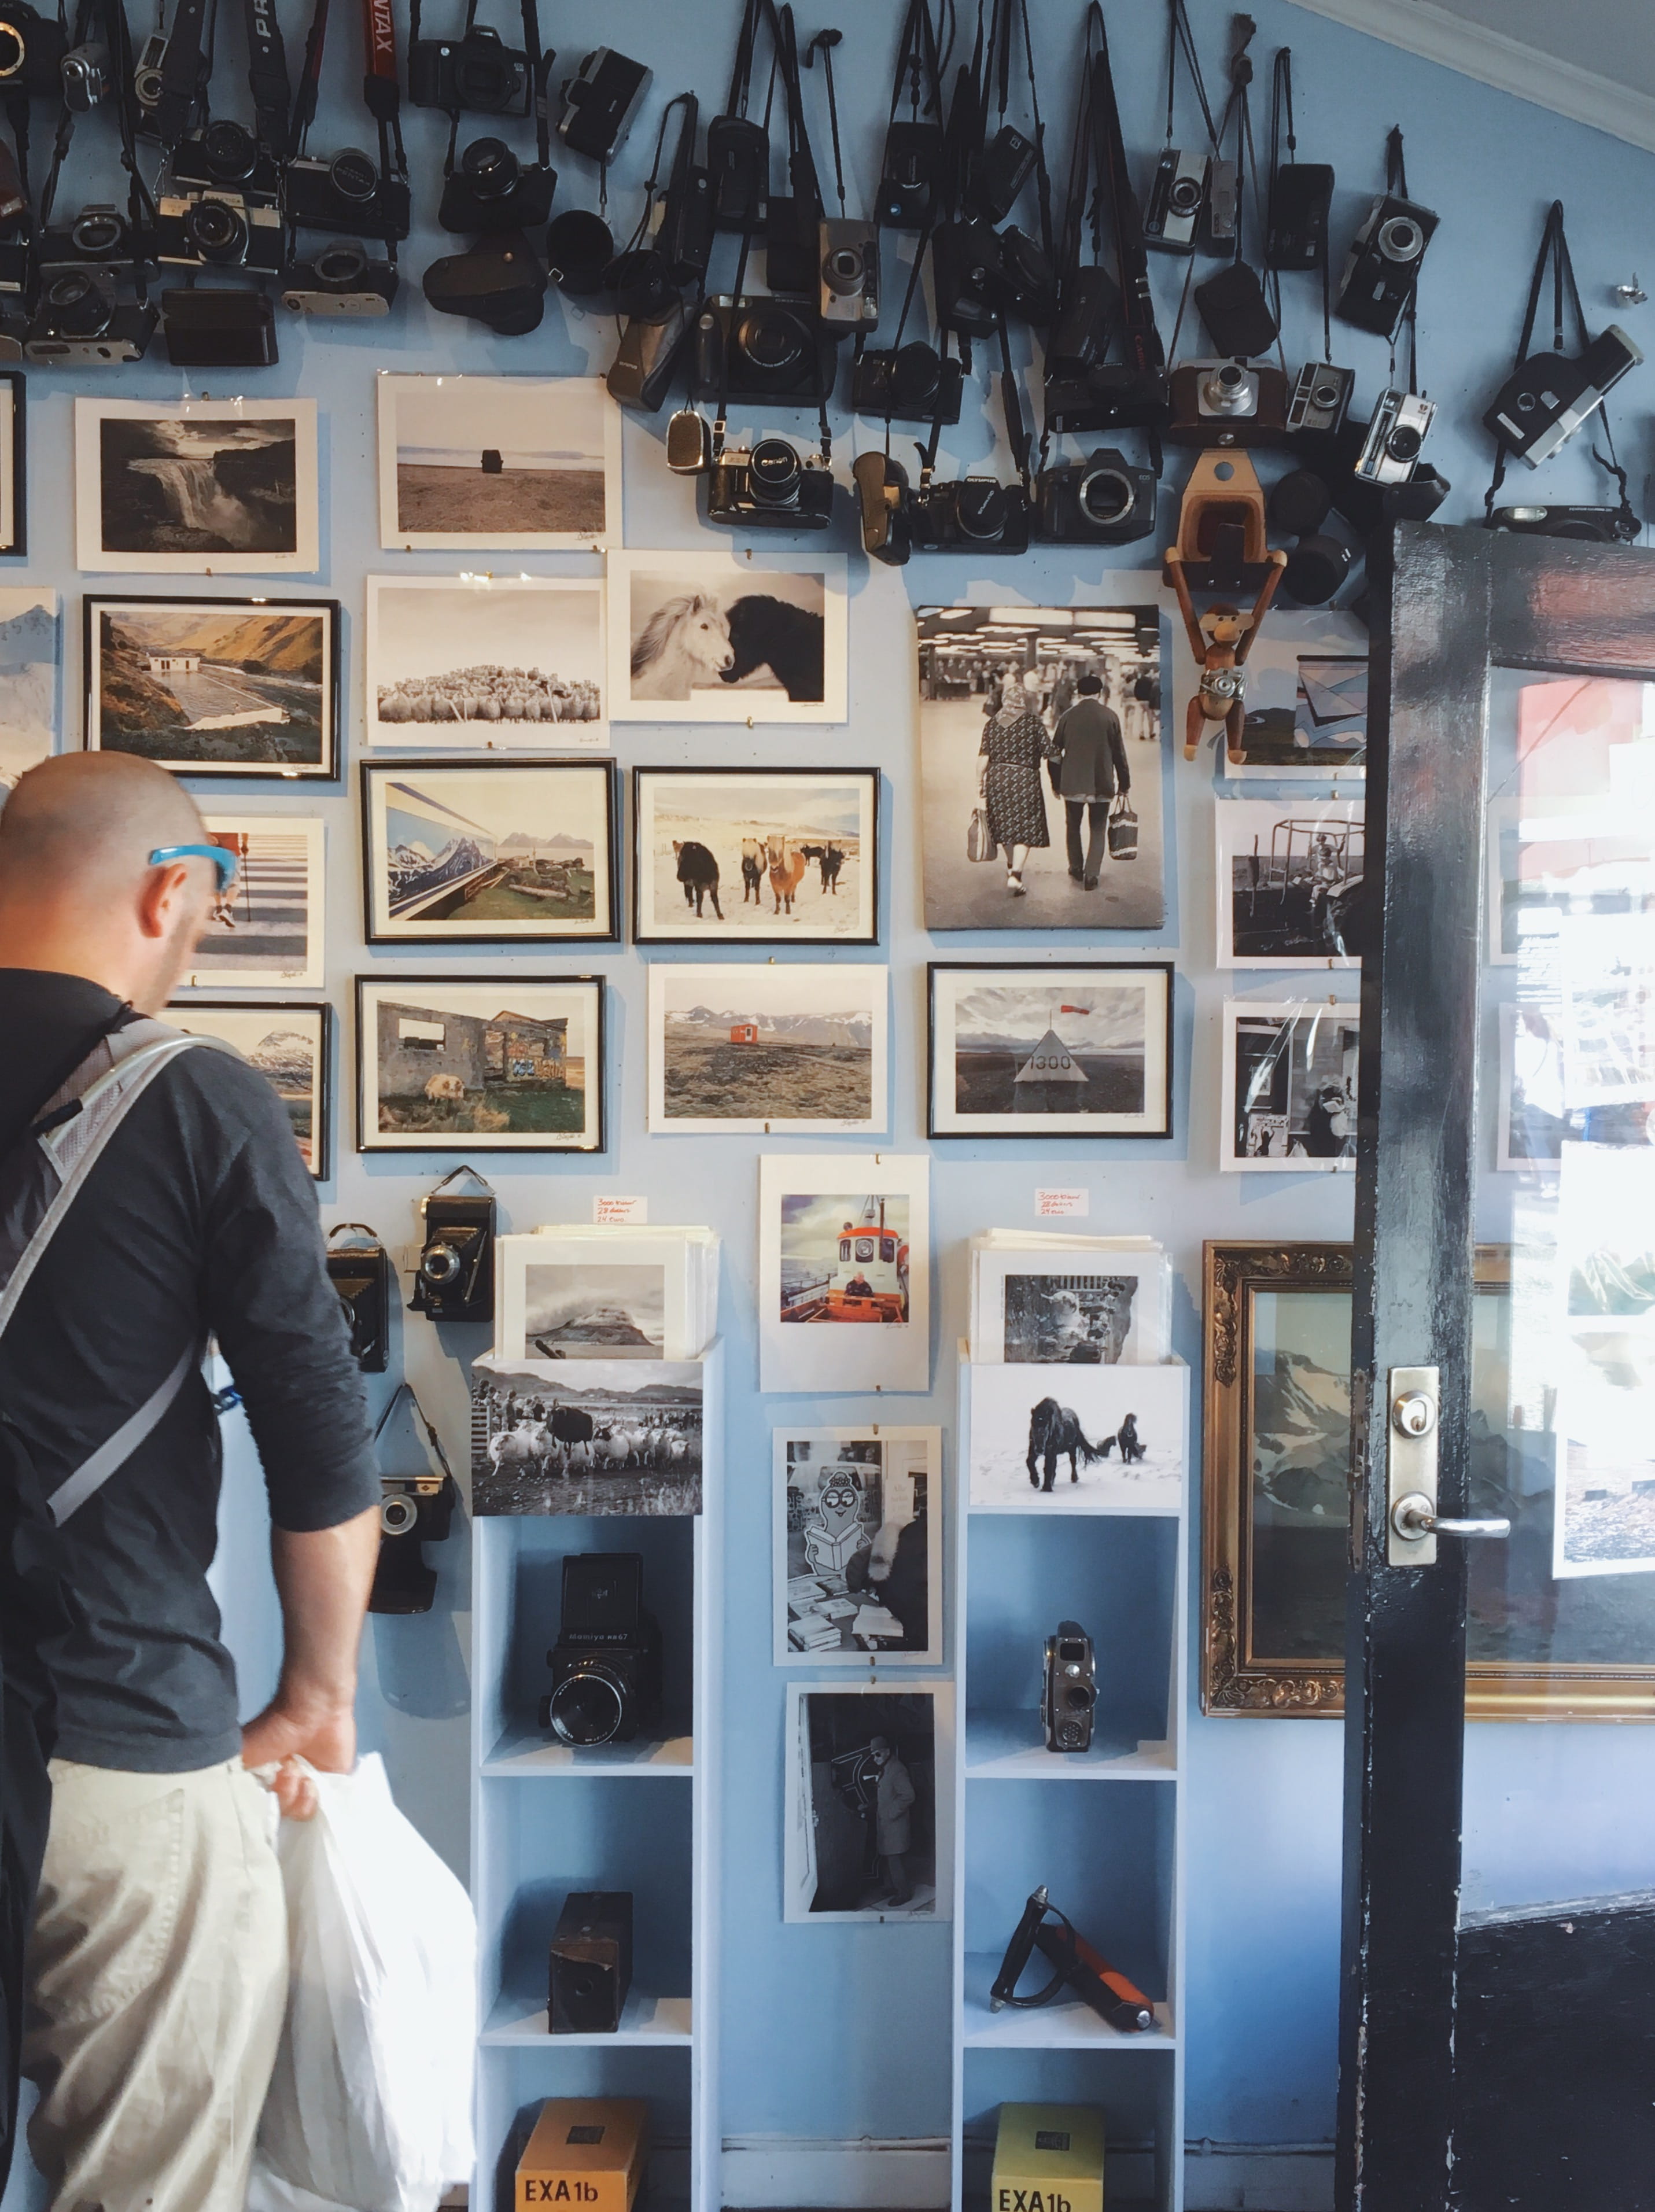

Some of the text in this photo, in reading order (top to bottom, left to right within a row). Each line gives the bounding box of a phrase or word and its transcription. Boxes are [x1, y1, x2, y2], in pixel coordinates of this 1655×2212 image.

[761, 456, 788, 467] Canon
[1030, 1055, 1071, 1070] 1300
[569, 1632, 605, 1642] Mamiya
